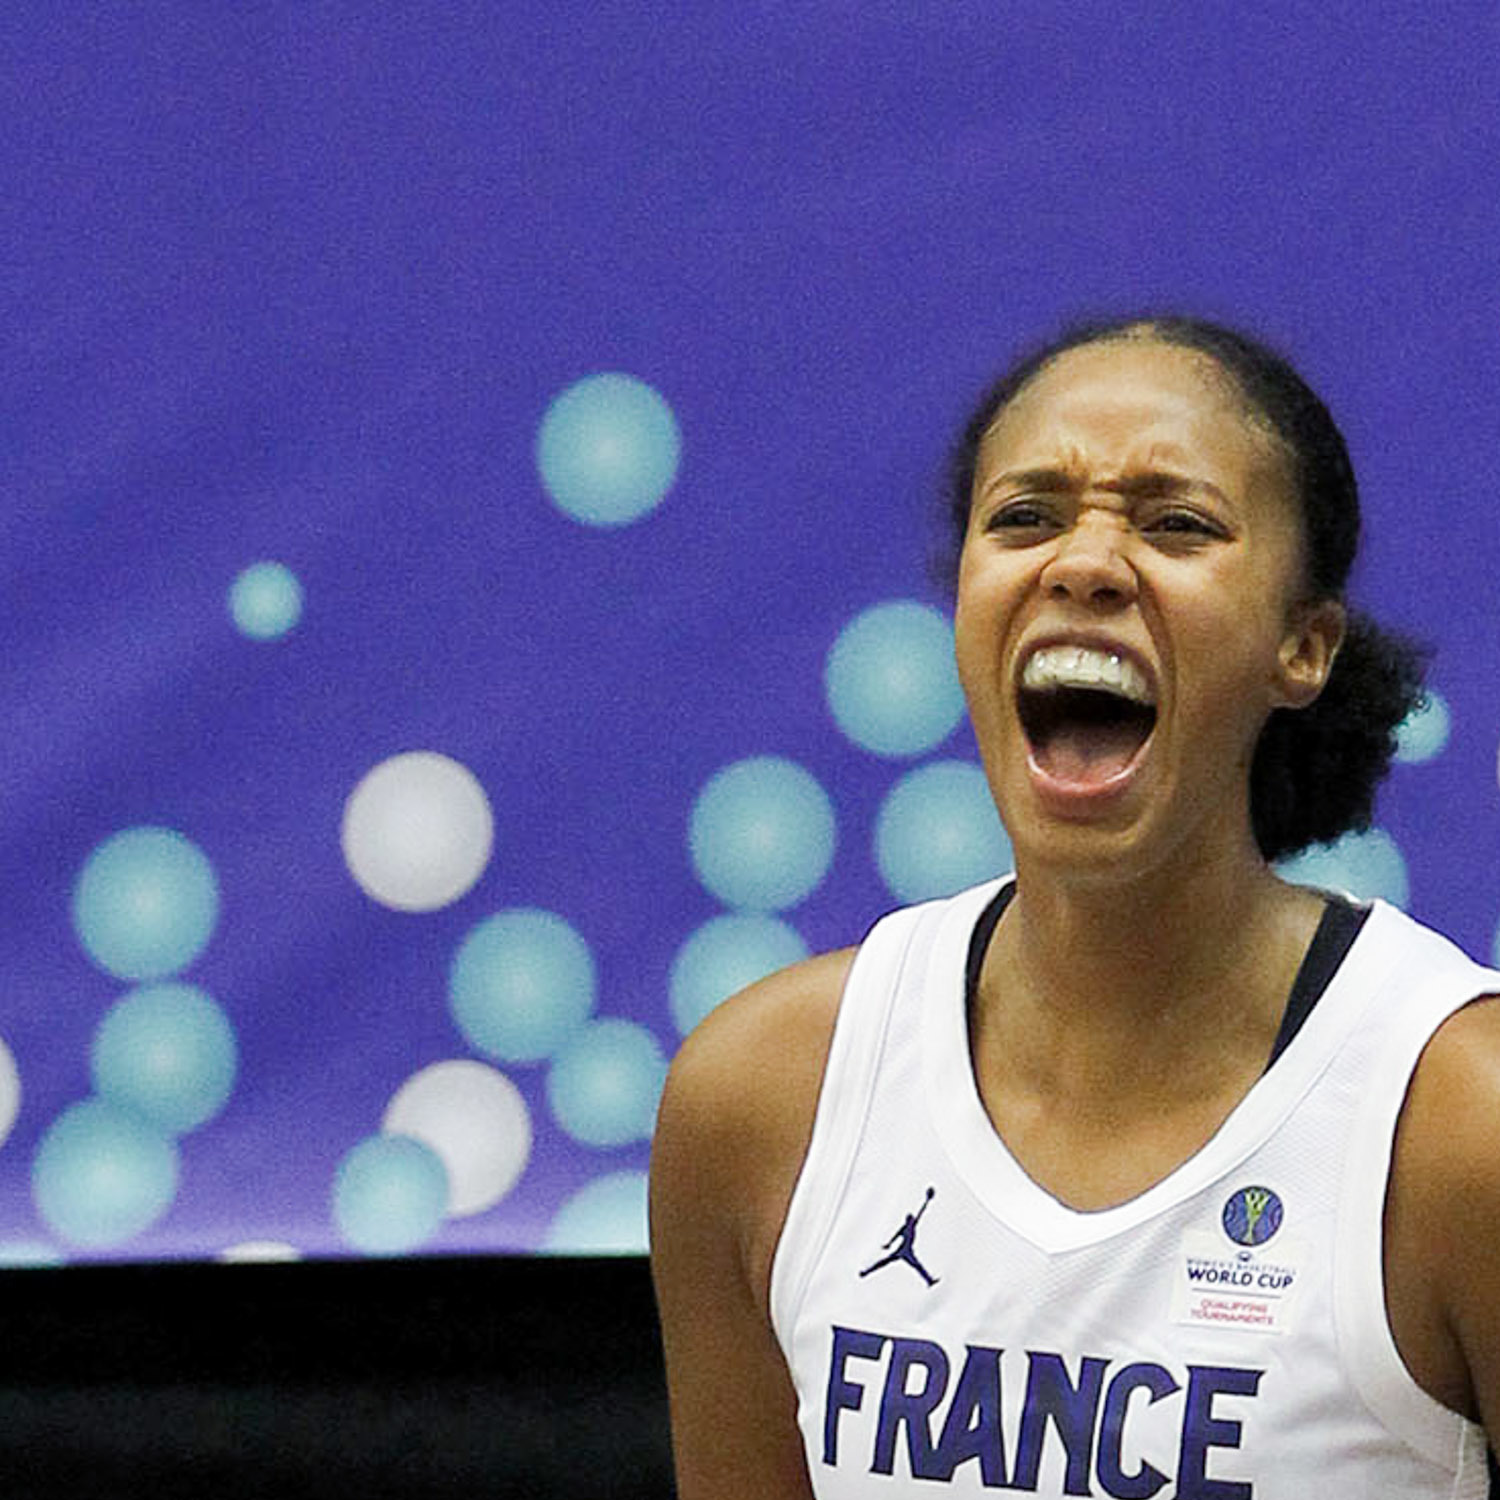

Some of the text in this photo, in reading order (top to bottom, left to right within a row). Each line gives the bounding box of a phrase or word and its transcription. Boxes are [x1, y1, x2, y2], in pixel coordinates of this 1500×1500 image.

[1187, 1267, 1293, 1289] WORLD CUP
[1200, 1299, 1268, 1313] QUALIFYING
[1190, 1308, 1274, 1325] TOURNAMENTS
